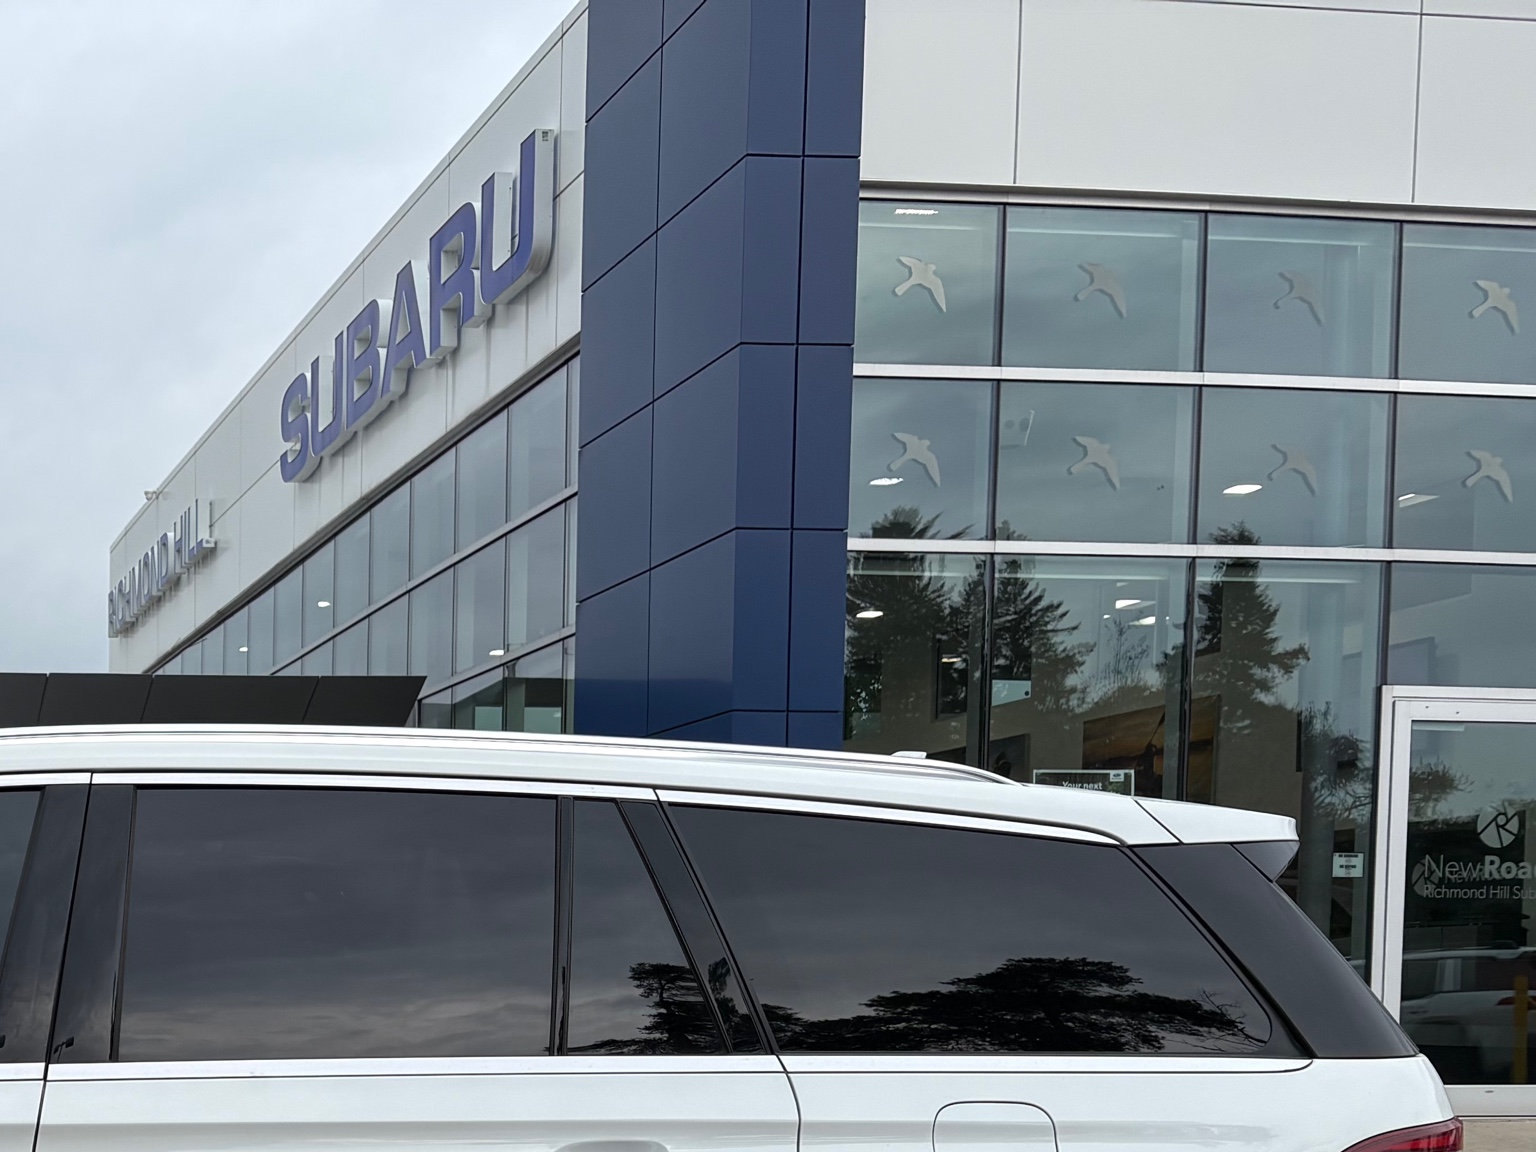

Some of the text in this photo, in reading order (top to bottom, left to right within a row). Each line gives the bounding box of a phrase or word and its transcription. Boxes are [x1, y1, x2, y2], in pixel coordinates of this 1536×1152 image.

[280, 129, 552, 483] SUBARU
[108, 499, 209, 637] RICHMOND HILL
[1084, 782, 1103, 790] next
[1424, 853, 1536, 880] NewRoa
[1424, 885, 1486, 899] Richmond
[1490, 885, 1510, 899] Hill
